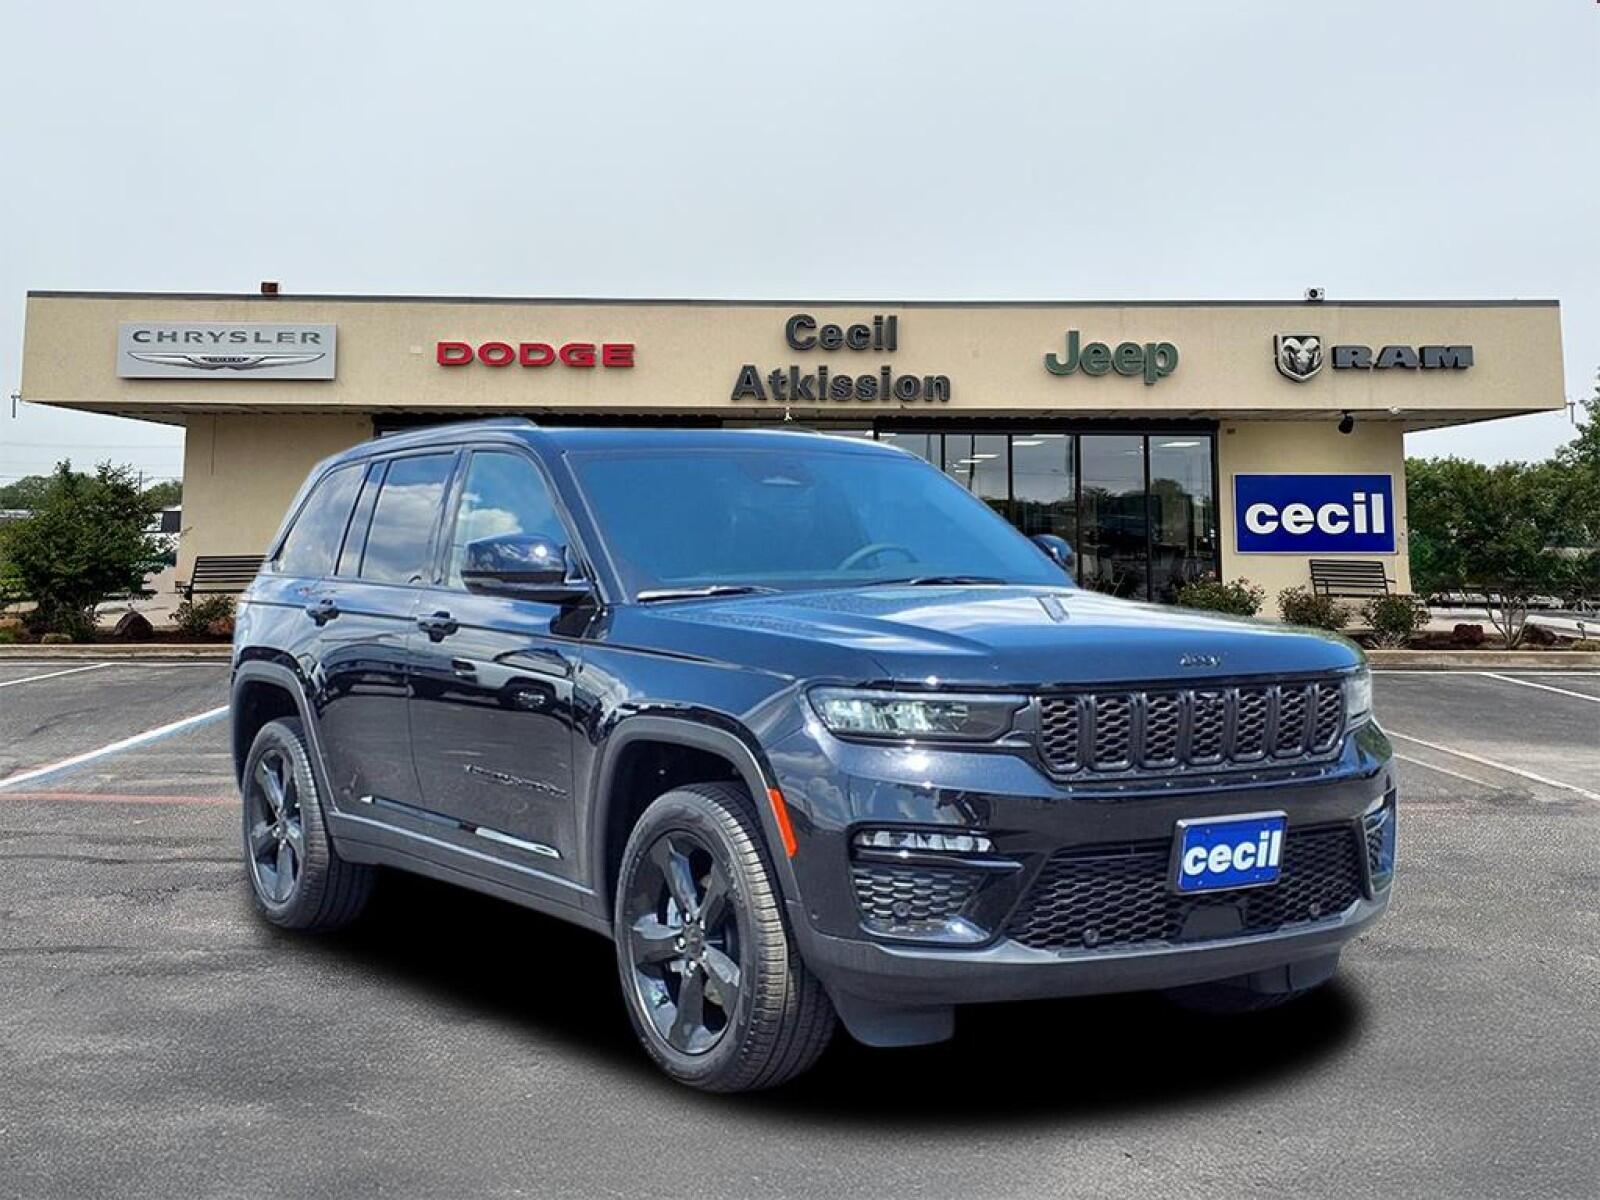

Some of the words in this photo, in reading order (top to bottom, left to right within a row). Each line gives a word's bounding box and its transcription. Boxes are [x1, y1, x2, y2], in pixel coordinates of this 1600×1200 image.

[132, 330, 321, 345] CHRYSLER
[785, 313, 898, 351] Cecil
[437, 341, 635, 367] DODGE
[1045, 330, 1179, 386] Jeep
[1331, 345, 1474, 369] RAM
[731, 364, 951, 402] Atkission
[1245, 491, 1385, 534] cecil
[1183, 830, 1282, 876] cecil
